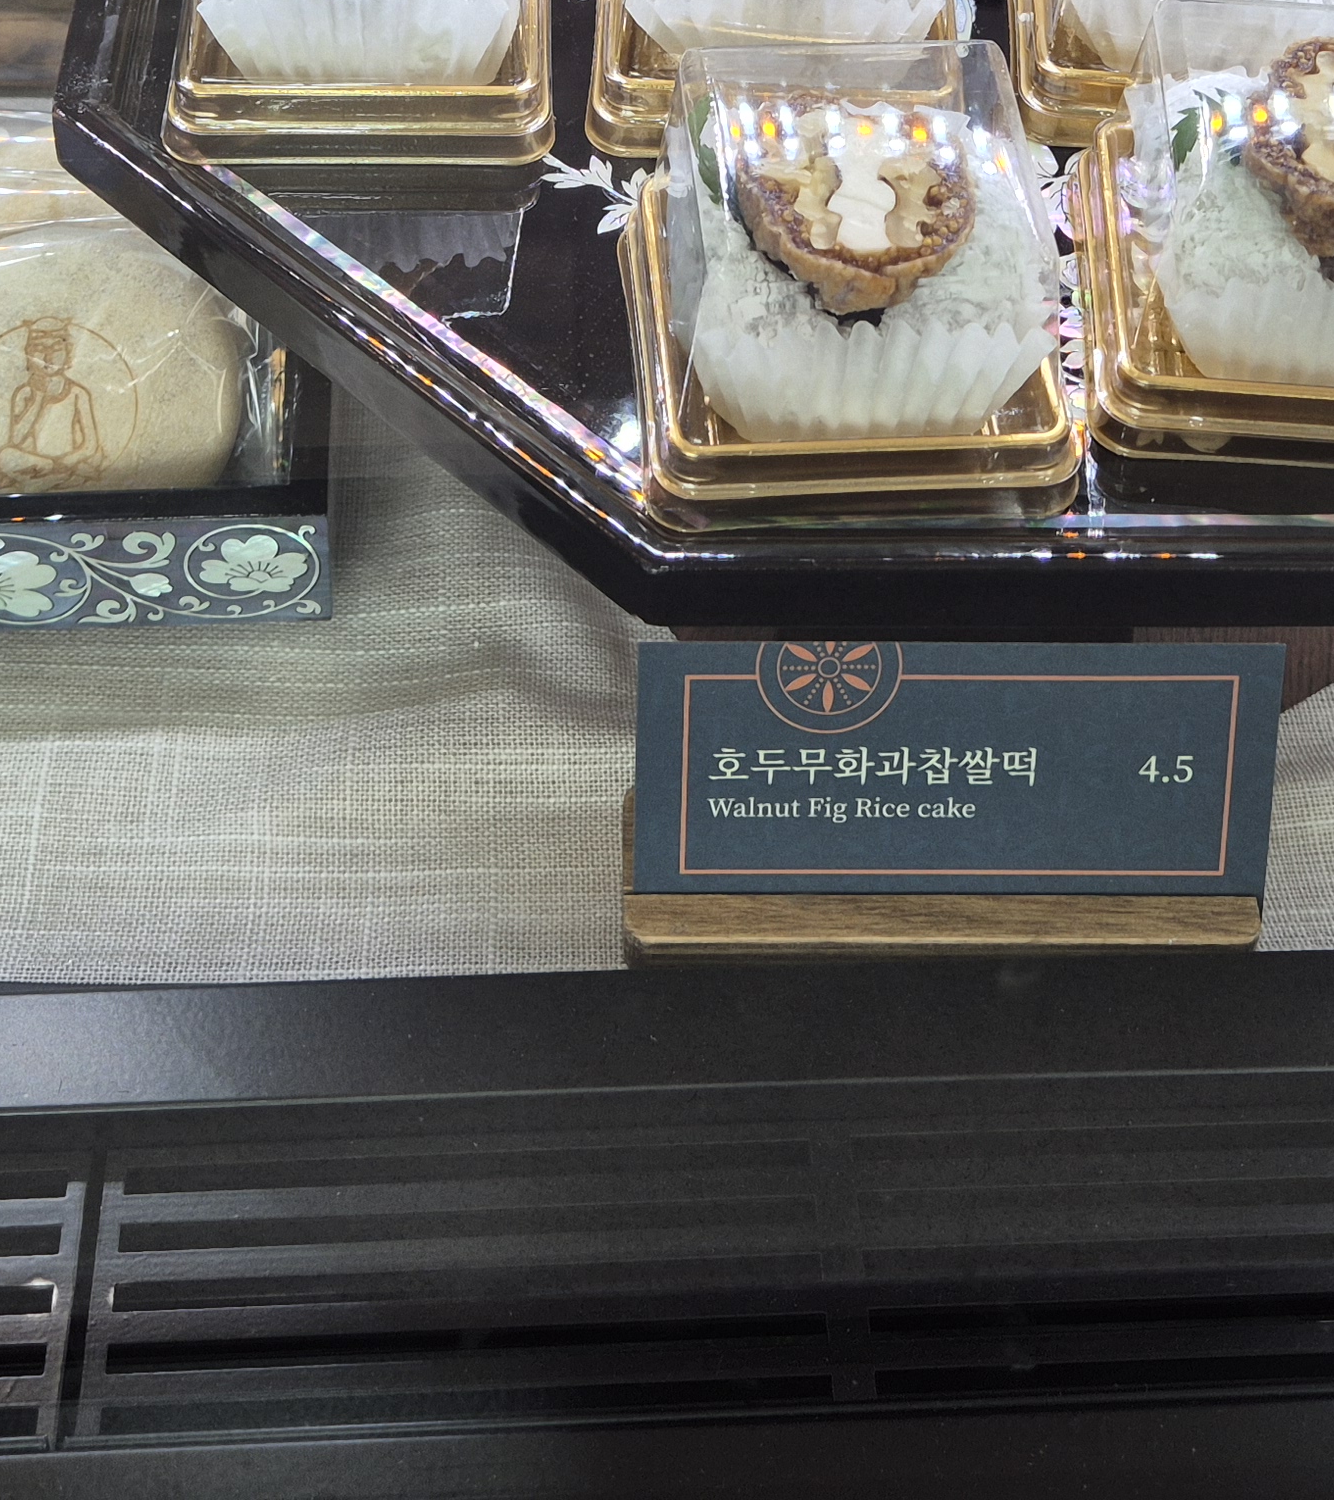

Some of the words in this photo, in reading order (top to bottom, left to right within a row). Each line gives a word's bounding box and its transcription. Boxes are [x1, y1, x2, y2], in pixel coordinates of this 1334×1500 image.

[708, 746, 1037, 787] 호두무화과찹쌀떡
[1138, 755, 1195, 784] 4.5
[707, 796, 801, 819] Walnut
[807, 796, 848, 824] Fig
[854, 796, 910, 819] Rice
[917, 796, 976, 819] cake
